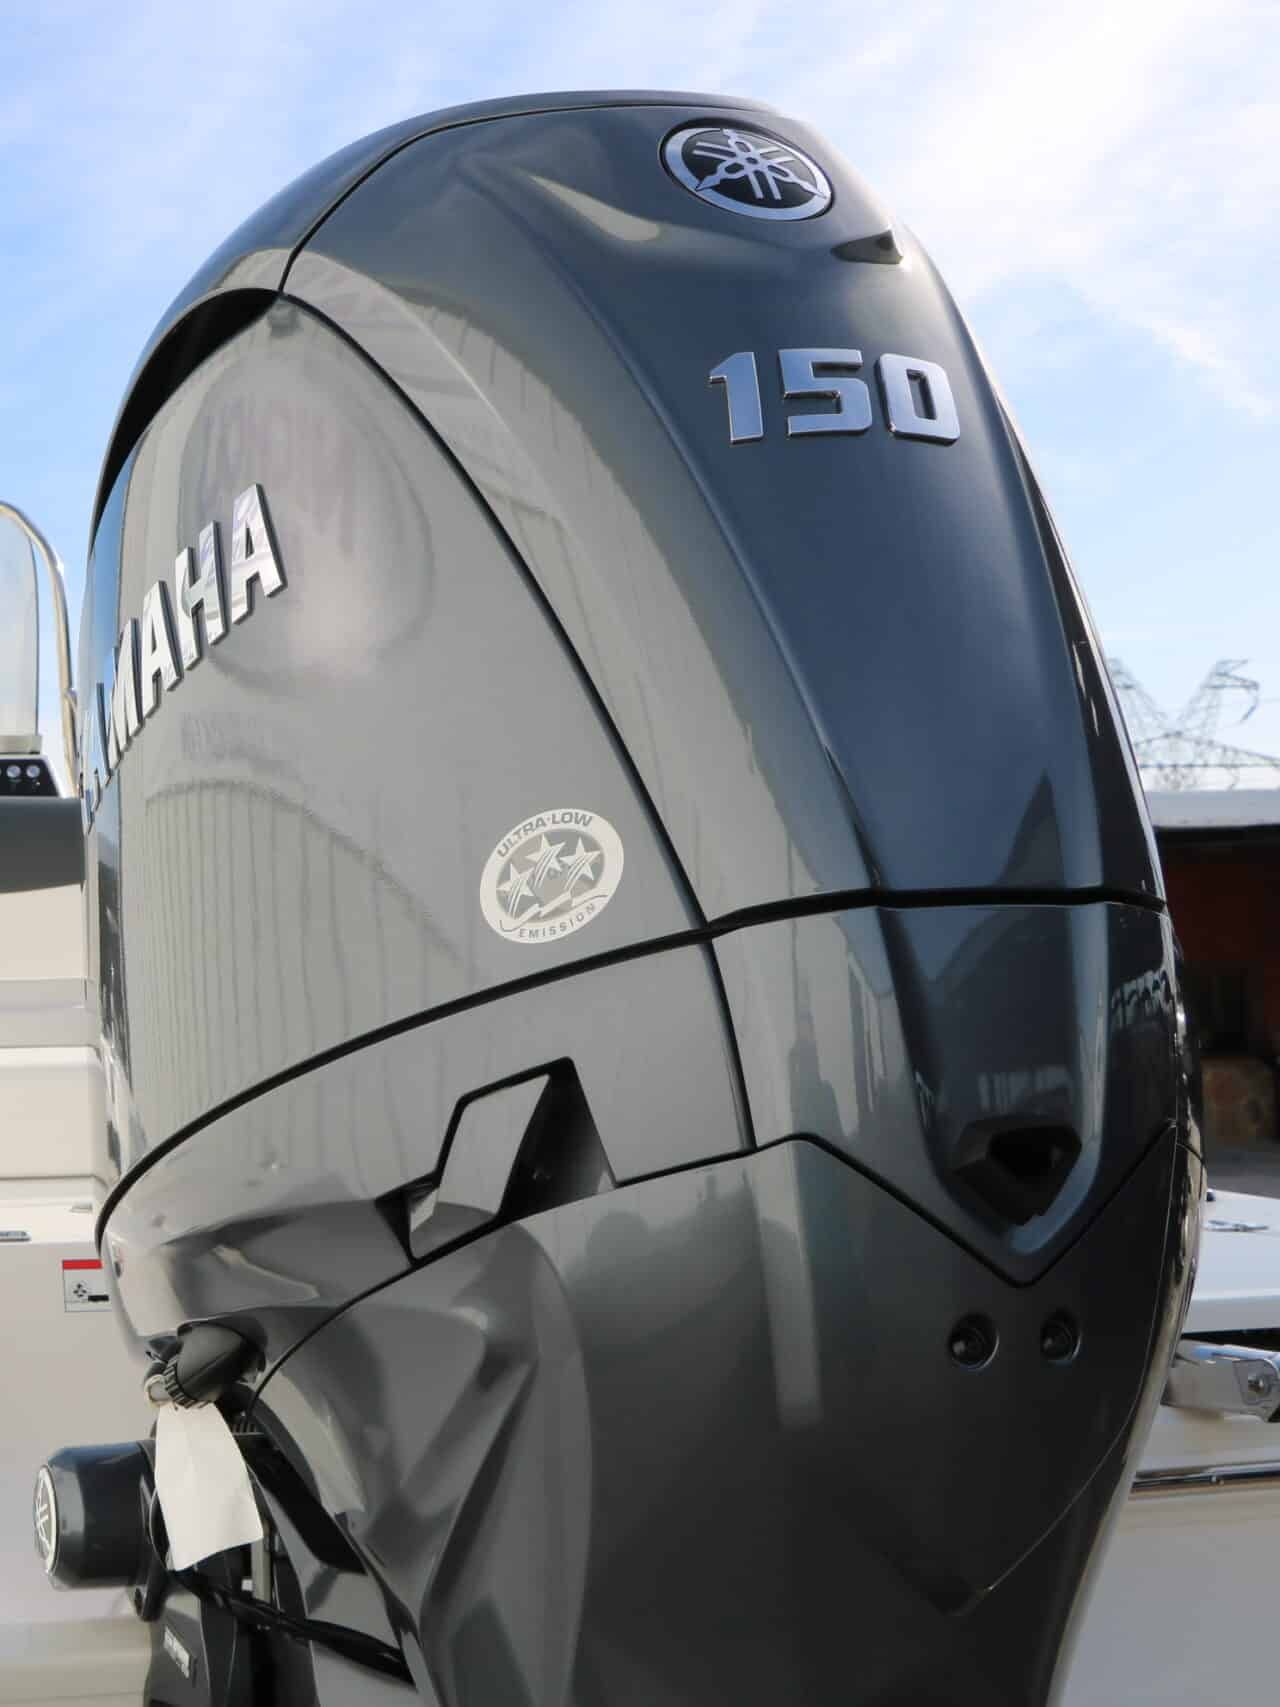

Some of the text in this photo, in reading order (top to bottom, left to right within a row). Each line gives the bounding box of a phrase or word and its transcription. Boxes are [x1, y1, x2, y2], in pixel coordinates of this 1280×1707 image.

[709, 348, 960, 445] 150
[83, 482, 288, 833] MAHA
[519, 903, 596, 939] EMISSION
